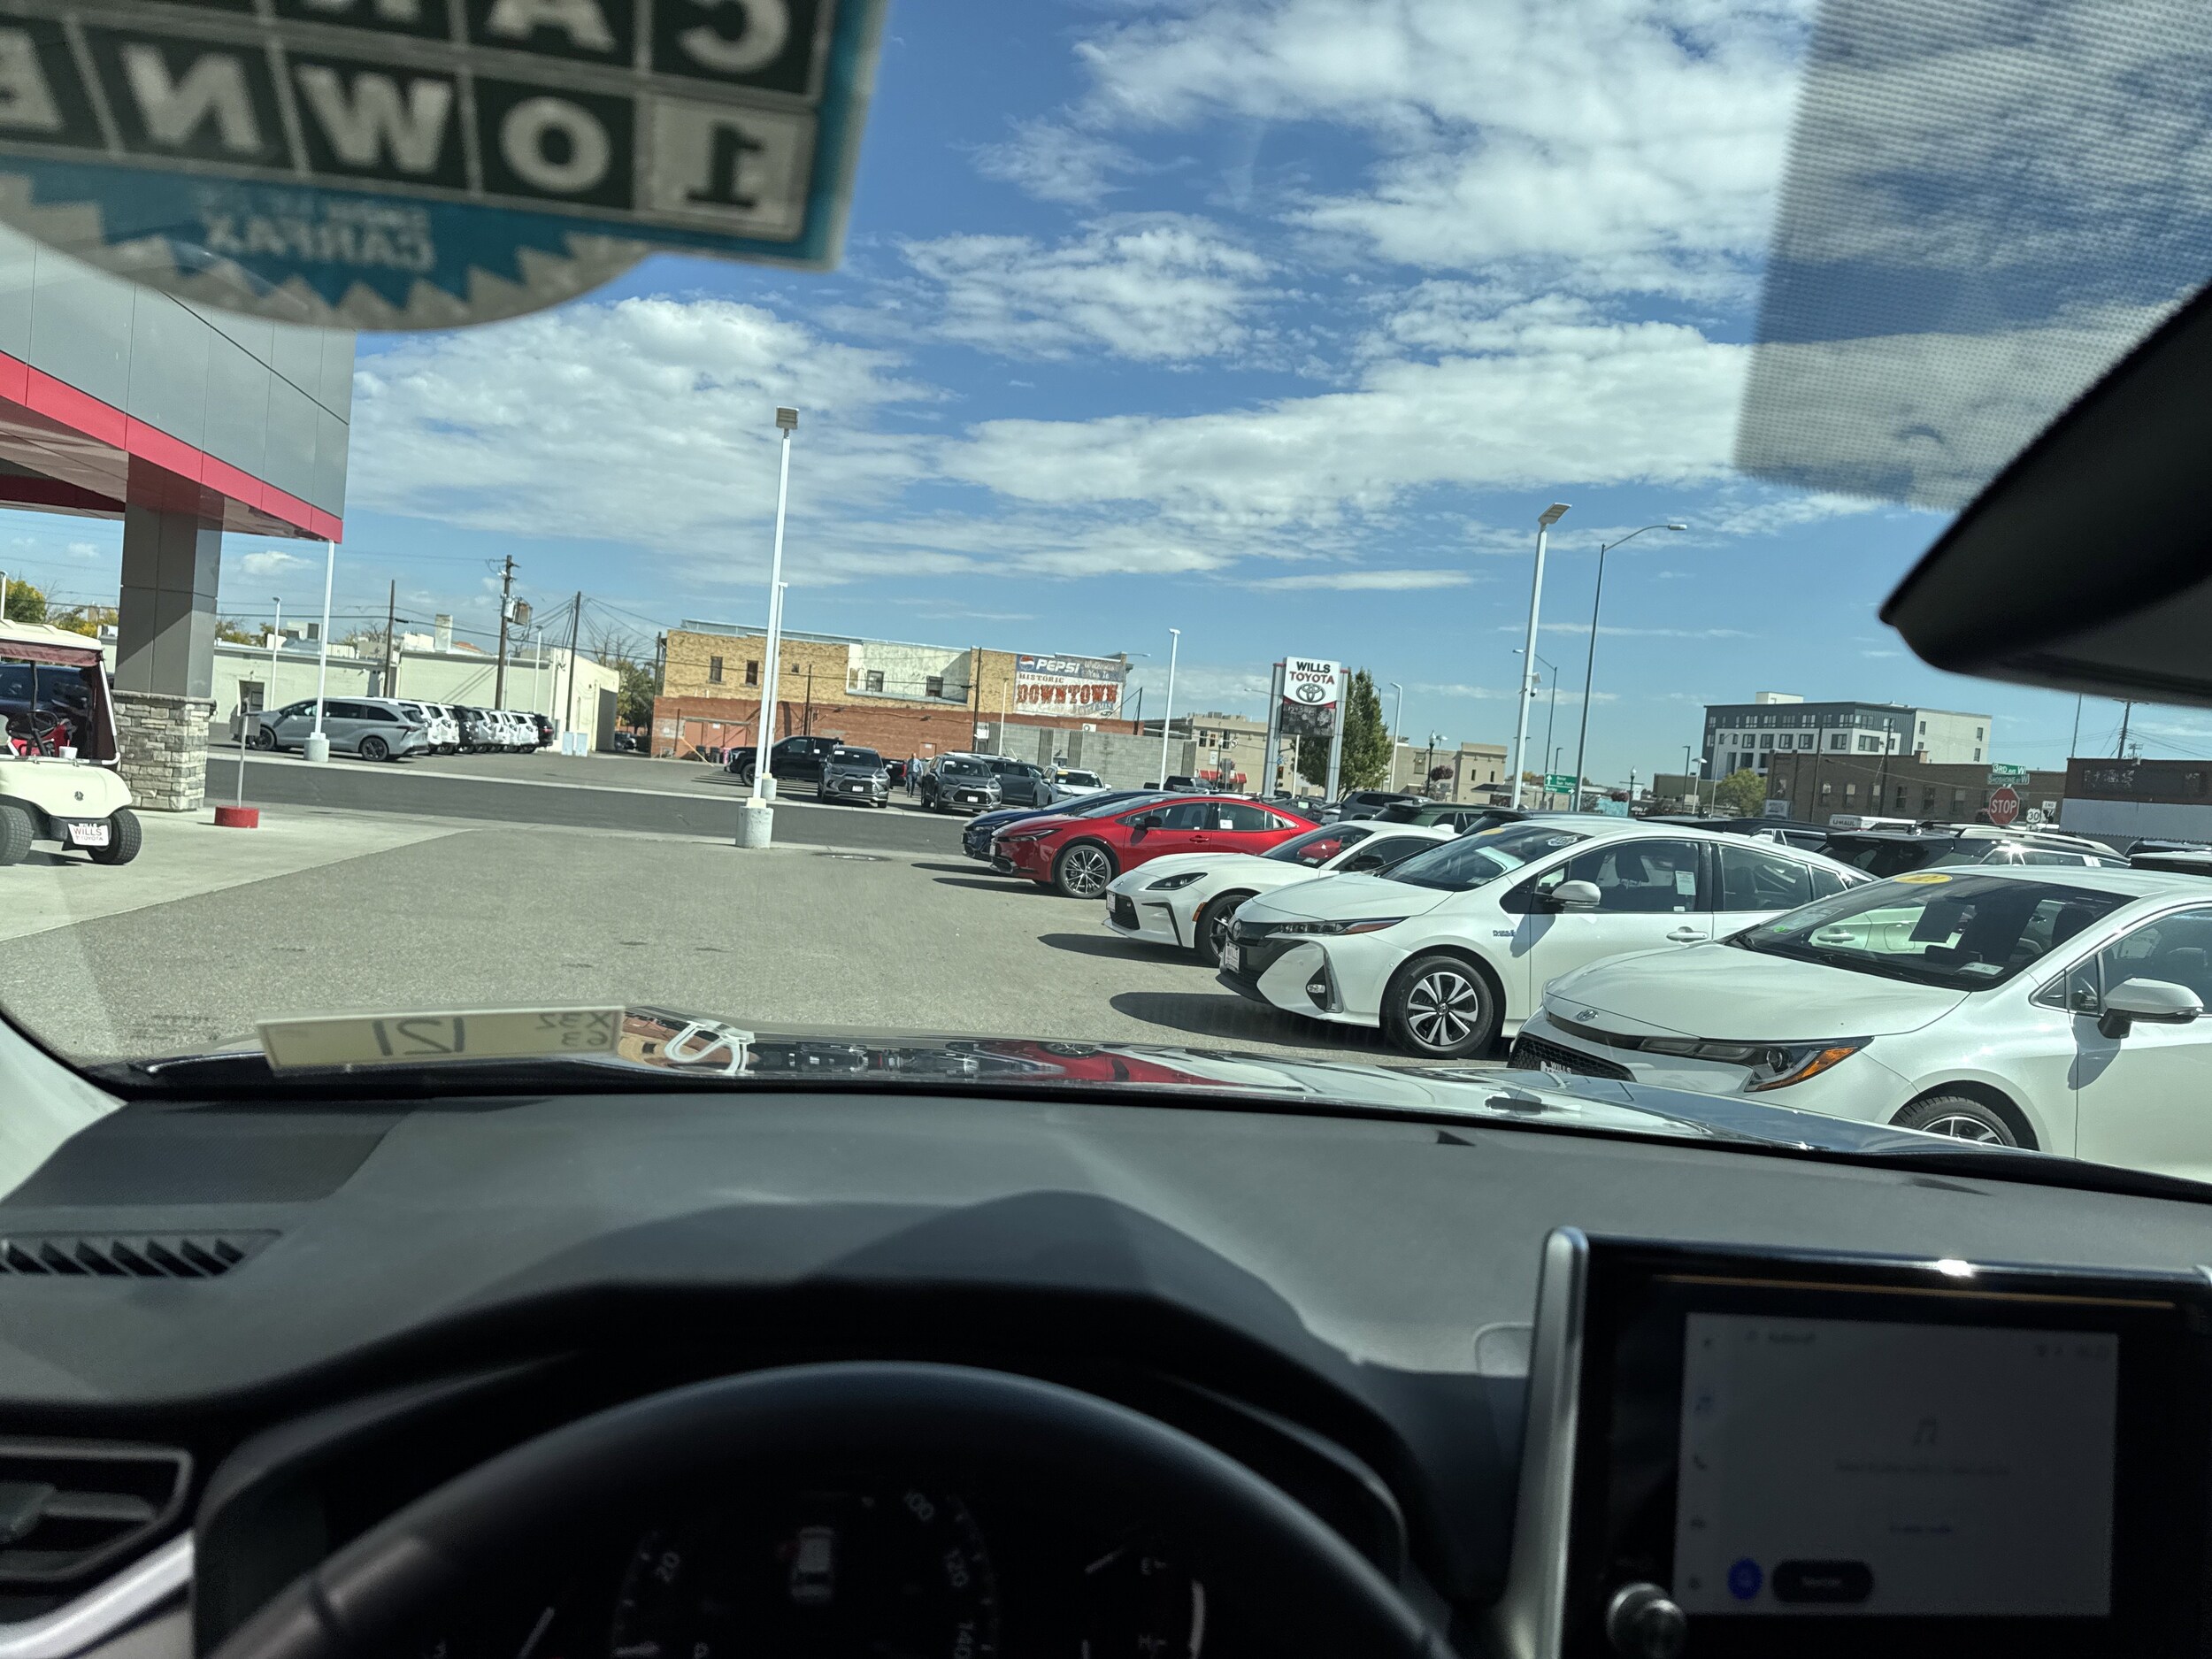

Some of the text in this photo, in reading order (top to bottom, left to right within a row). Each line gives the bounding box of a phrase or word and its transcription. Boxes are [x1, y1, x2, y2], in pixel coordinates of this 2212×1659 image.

[1036, 658, 1080, 673] PEPSI
[1296, 661, 1331, 673] WILLS
[1019, 672, 1064, 683] HISTORIC
[1289, 671, 1335, 685] TOYOTA
[1017, 683, 1118, 705] DOWNTOWN
[1993, 764, 2008, 773] 3RD
[1991, 800, 2017, 814] STOP
[2028, 811, 2039, 820] 30
[73, 827, 102, 836] WILLS
[1550, 1062, 1572, 1074] WILLS
[653, 1549, 682, 1585] 20
[942, 1548, 971, 1589] 120
